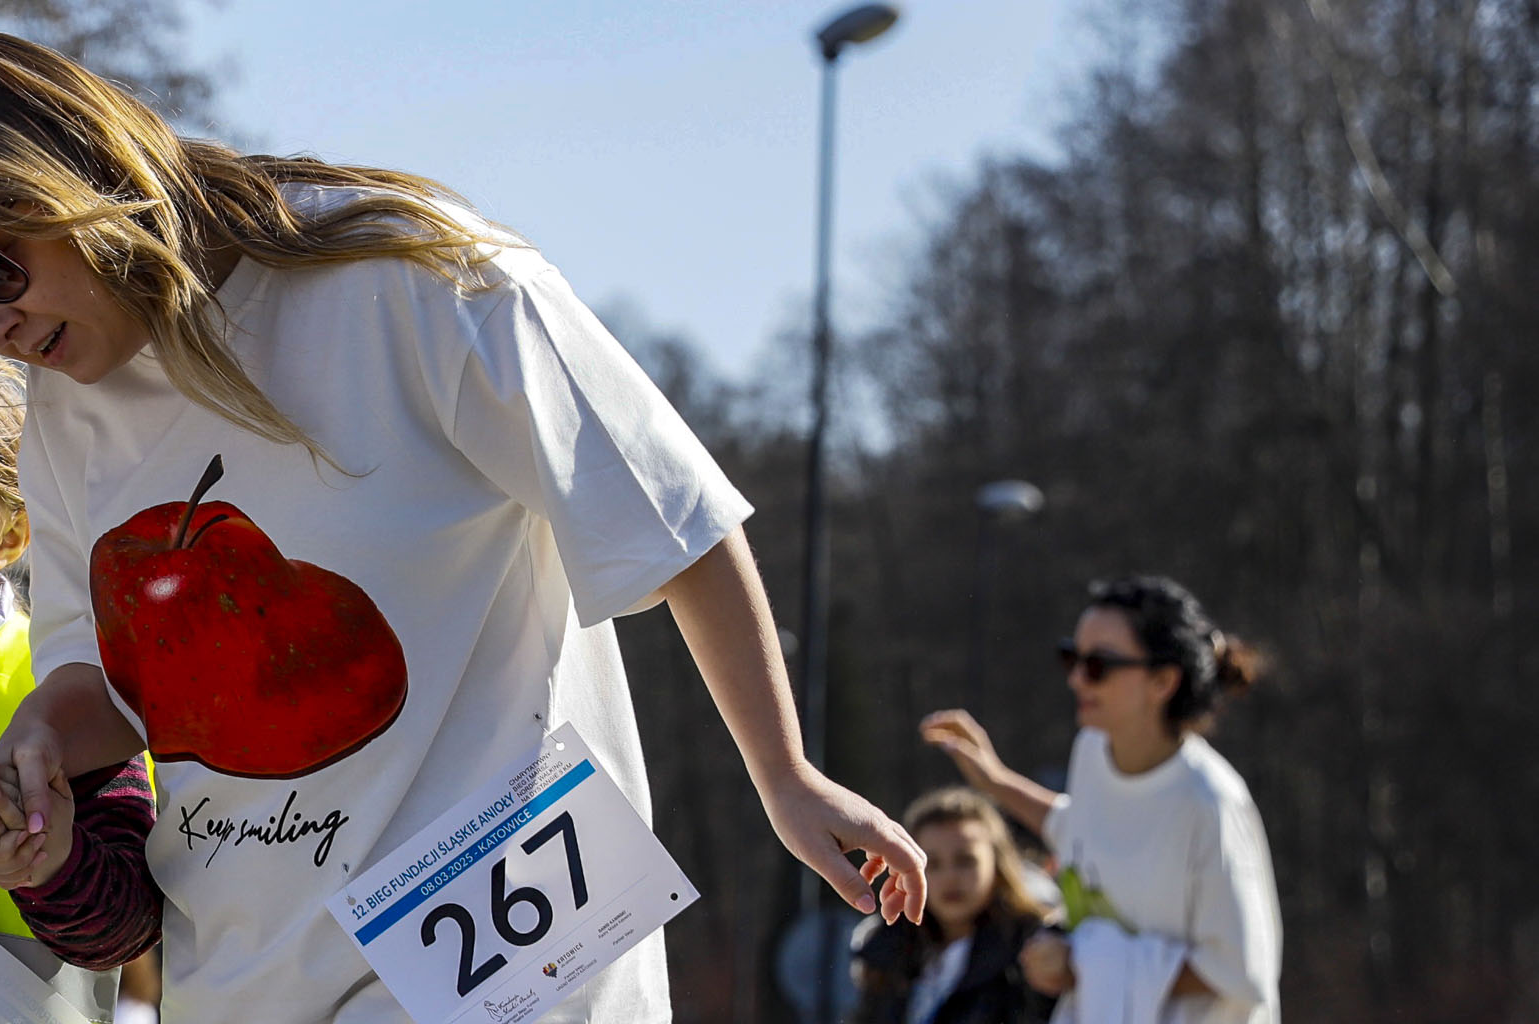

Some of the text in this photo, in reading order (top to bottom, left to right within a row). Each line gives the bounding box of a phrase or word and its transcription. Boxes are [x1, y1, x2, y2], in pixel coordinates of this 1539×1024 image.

[508, 752, 551, 786] CHARYTATYWNY
[516, 760, 563, 798] NORDIC WALKING
[179, 790, 350, 868] Keep smiling
[352, 792, 515, 920] 12. BIEG FUNDACJI ŚLĄSKIE ANIOŁY
[420, 852, 474, 896] 08.03.2025
[477, 808, 533, 854] KATOWICE
[420, 810, 589, 998] 267
[557, 942, 584, 964] KATOWICE
